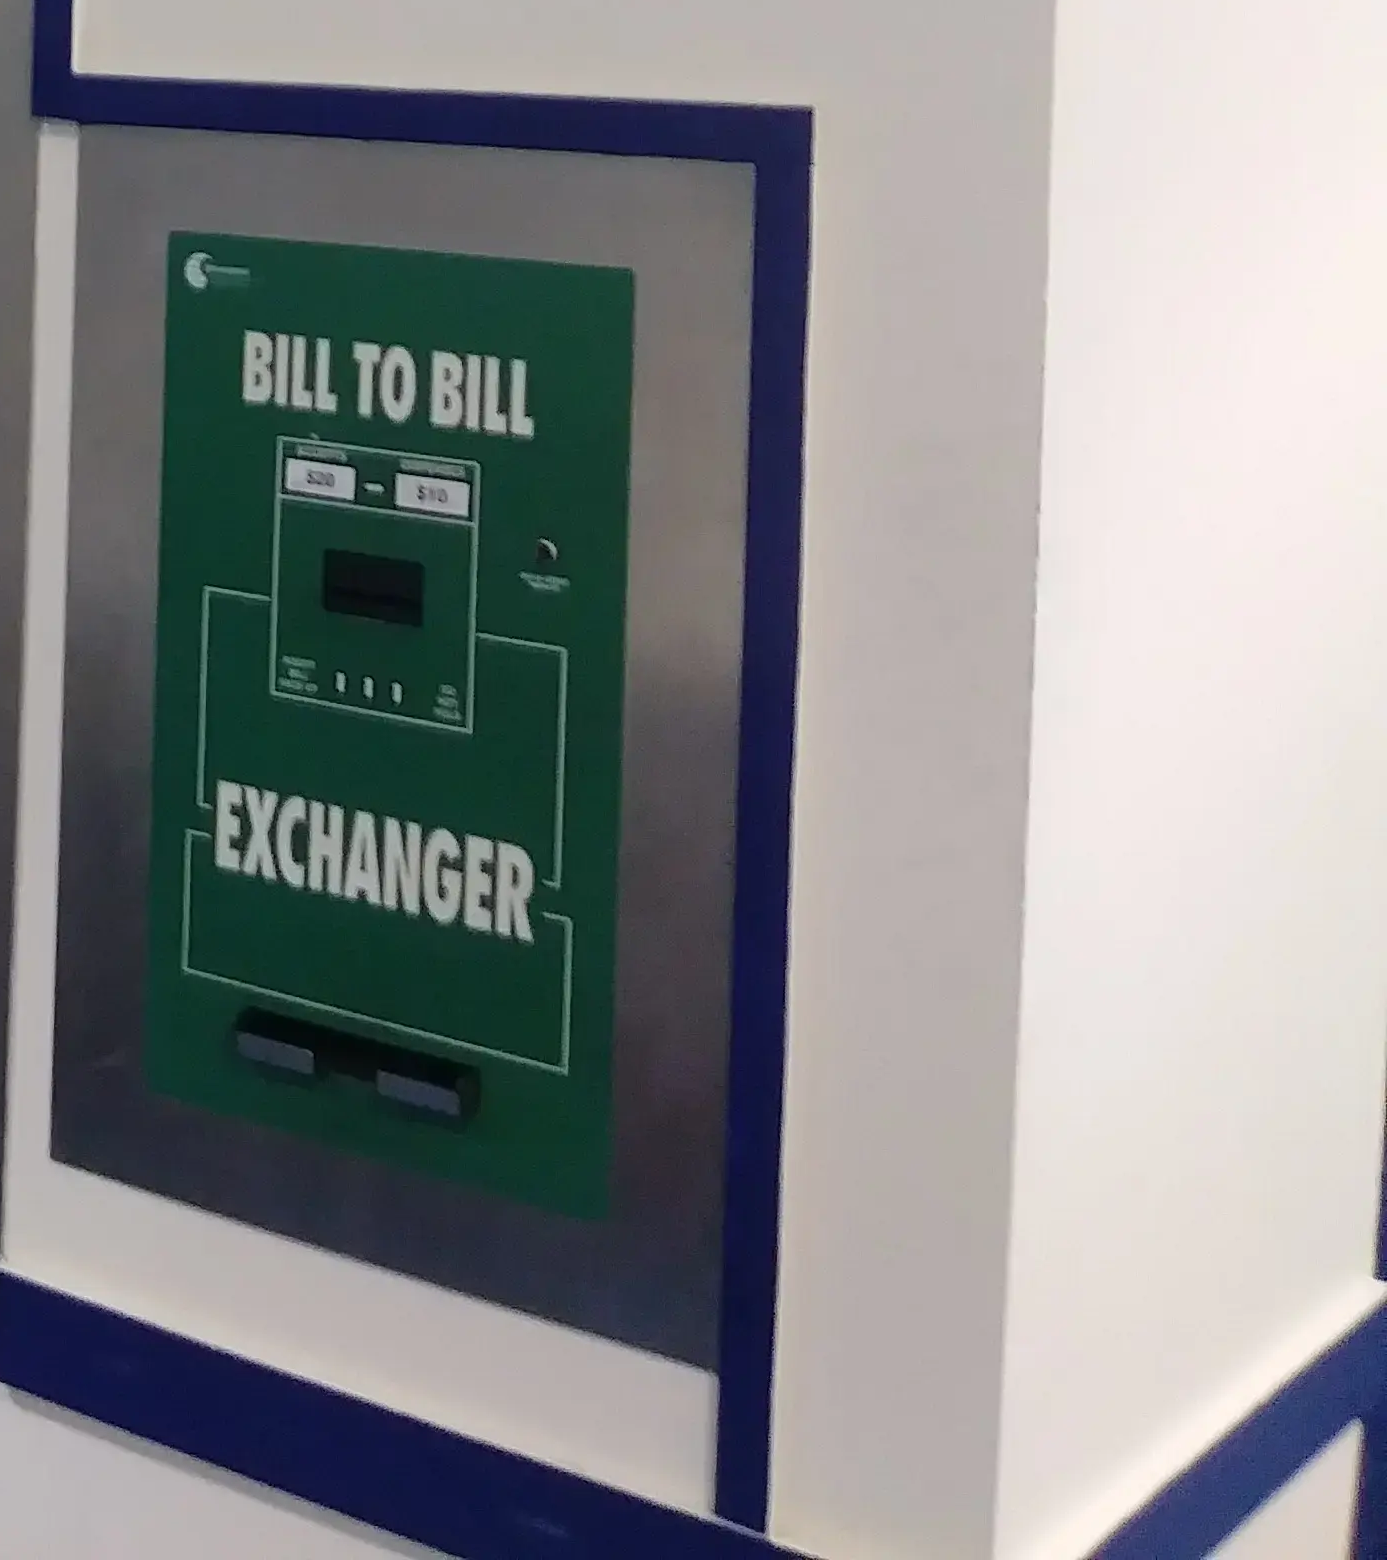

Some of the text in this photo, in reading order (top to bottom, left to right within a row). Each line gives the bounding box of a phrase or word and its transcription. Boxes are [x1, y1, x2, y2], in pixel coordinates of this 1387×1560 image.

[242, 329, 534, 439] BILL TO BILL
[214, 779, 535, 944] EXCHANGER
